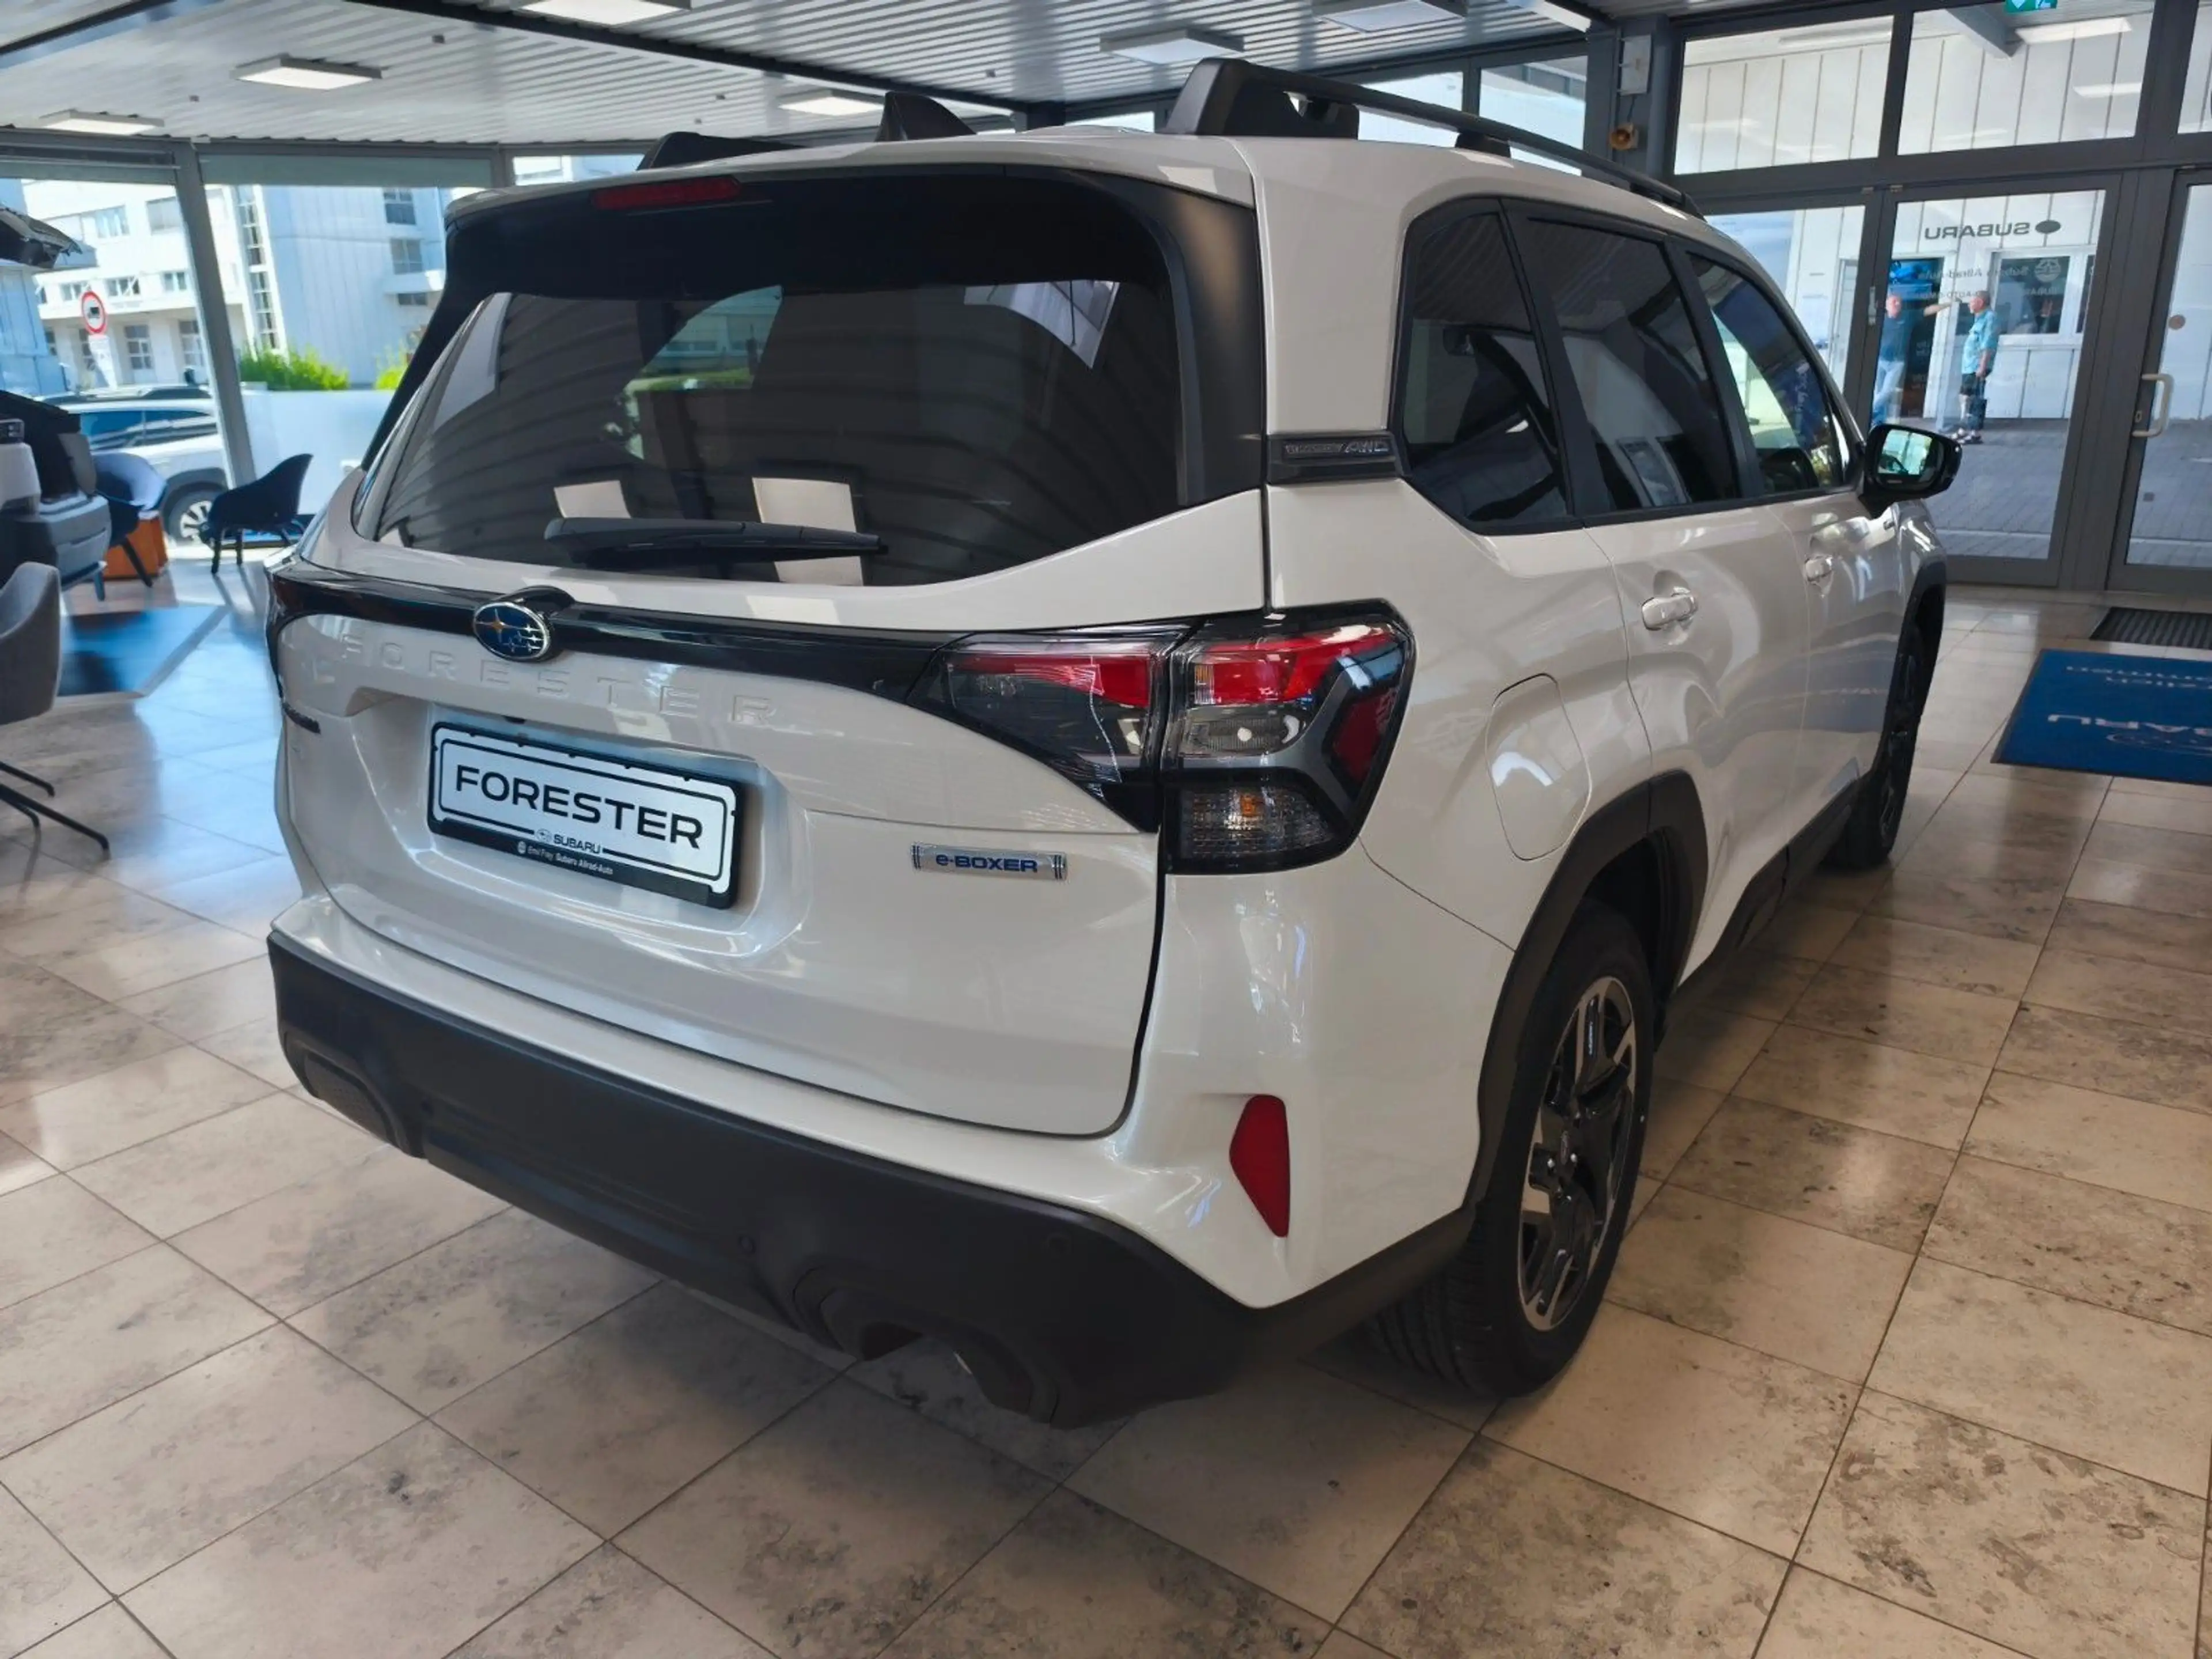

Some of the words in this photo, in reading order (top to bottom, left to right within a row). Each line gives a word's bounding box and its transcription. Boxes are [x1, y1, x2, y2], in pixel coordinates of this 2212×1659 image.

[342, 634, 777, 725] FORESTER
[456, 764, 703, 849] FORESTER
[554, 834, 601, 854] SUBARU
[935, 854, 1037, 873] e-BOXER
